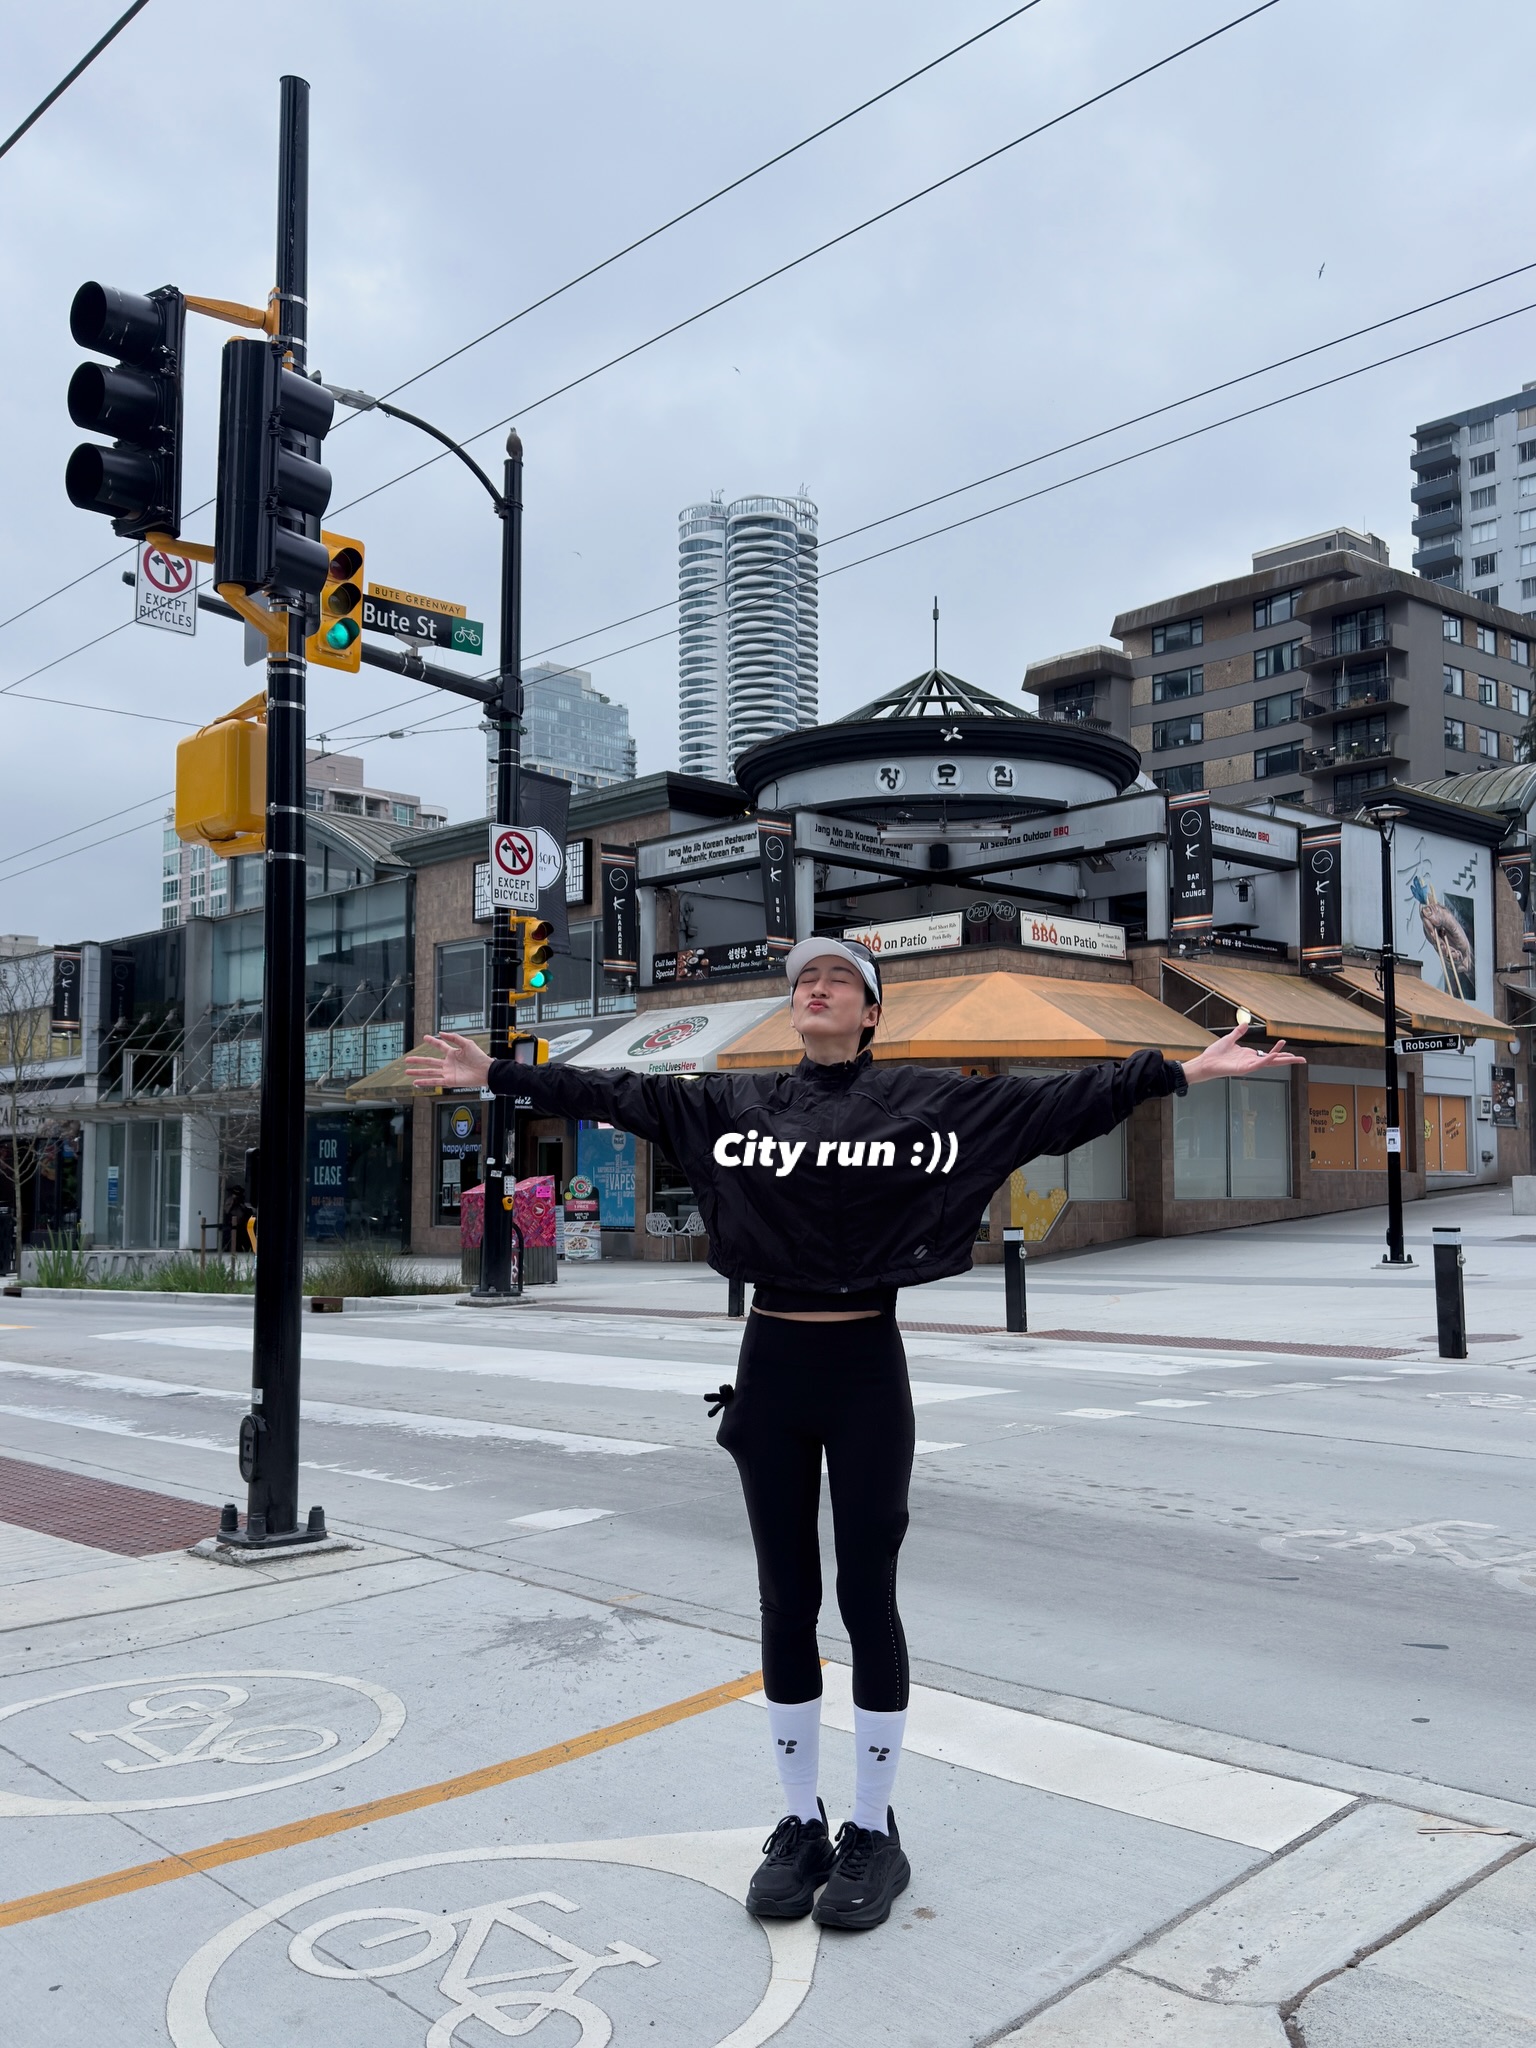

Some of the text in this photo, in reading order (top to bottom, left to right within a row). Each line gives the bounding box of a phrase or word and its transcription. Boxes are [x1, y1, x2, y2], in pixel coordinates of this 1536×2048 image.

[145, 592, 188, 613] EXCEPT
[375, 586, 461, 615] BUTE GREENWAY
[139, 605, 192, 628] BICYCLES
[363, 602, 438, 639] Bute St
[814, 823, 878, 845] Jang Mo Jib Korean
[1022, 830, 1052, 843] Outdoor
[1053, 825, 1069, 837] BBQ
[1211, 820, 1270, 843] Seasons Outdoor BBQ
[667, 830, 758, 858] Jang Mo Jib Korean Restaurant
[680, 844, 745, 865] Authentic Korean Fare
[829, 837, 860, 851] Authentic
[861, 843, 885, 858] Korean
[885, 848, 900, 859] Fare
[498, 876, 531, 891] EXCEPT
[1186, 872, 1200, 881] BAR
[494, 888, 535, 904] BICYCLES
[1181, 889, 1207, 899] LOUNGE
[856, 931, 928, 953] BQ on Patio
[1031, 920, 1098, 949] BBQ on Patio
[665, 957, 677, 966] back
[655, 967, 676, 980] Special
[1405, 1040, 1443, 1051] Robson
[648, 1061, 697, 1073] FreshLivesHere
[318, 1138, 338, 1159] FOR
[313, 1165, 342, 1185] LEASE
[609, 1173, 635, 1191] VAPES
